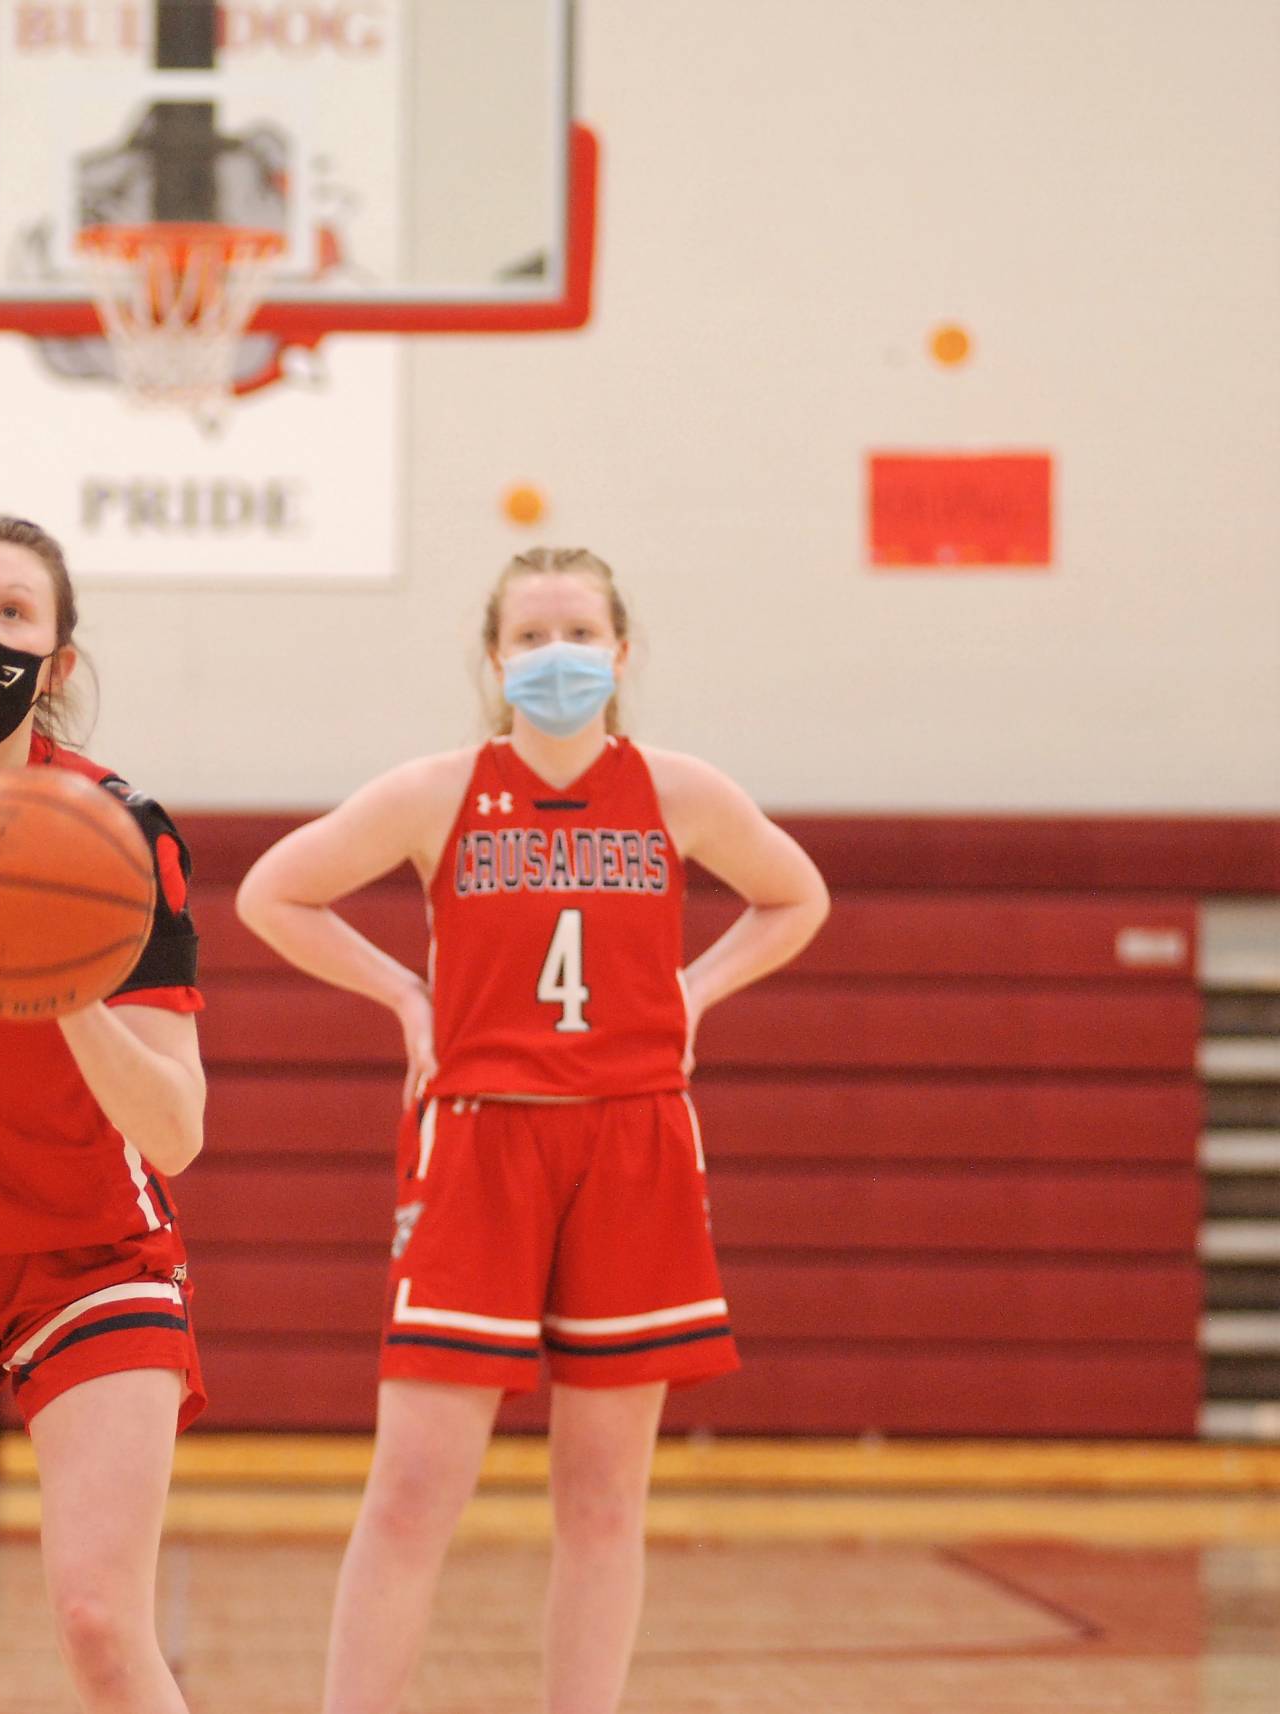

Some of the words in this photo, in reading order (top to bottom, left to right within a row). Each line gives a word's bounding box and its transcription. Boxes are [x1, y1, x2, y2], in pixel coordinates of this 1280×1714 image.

[14, 0, 383, 54] BULDOG
[80, 480, 305, 534] PRIDE
[454, 827, 668, 895] CRUSADERS
[535, 907, 592, 1034] 4
